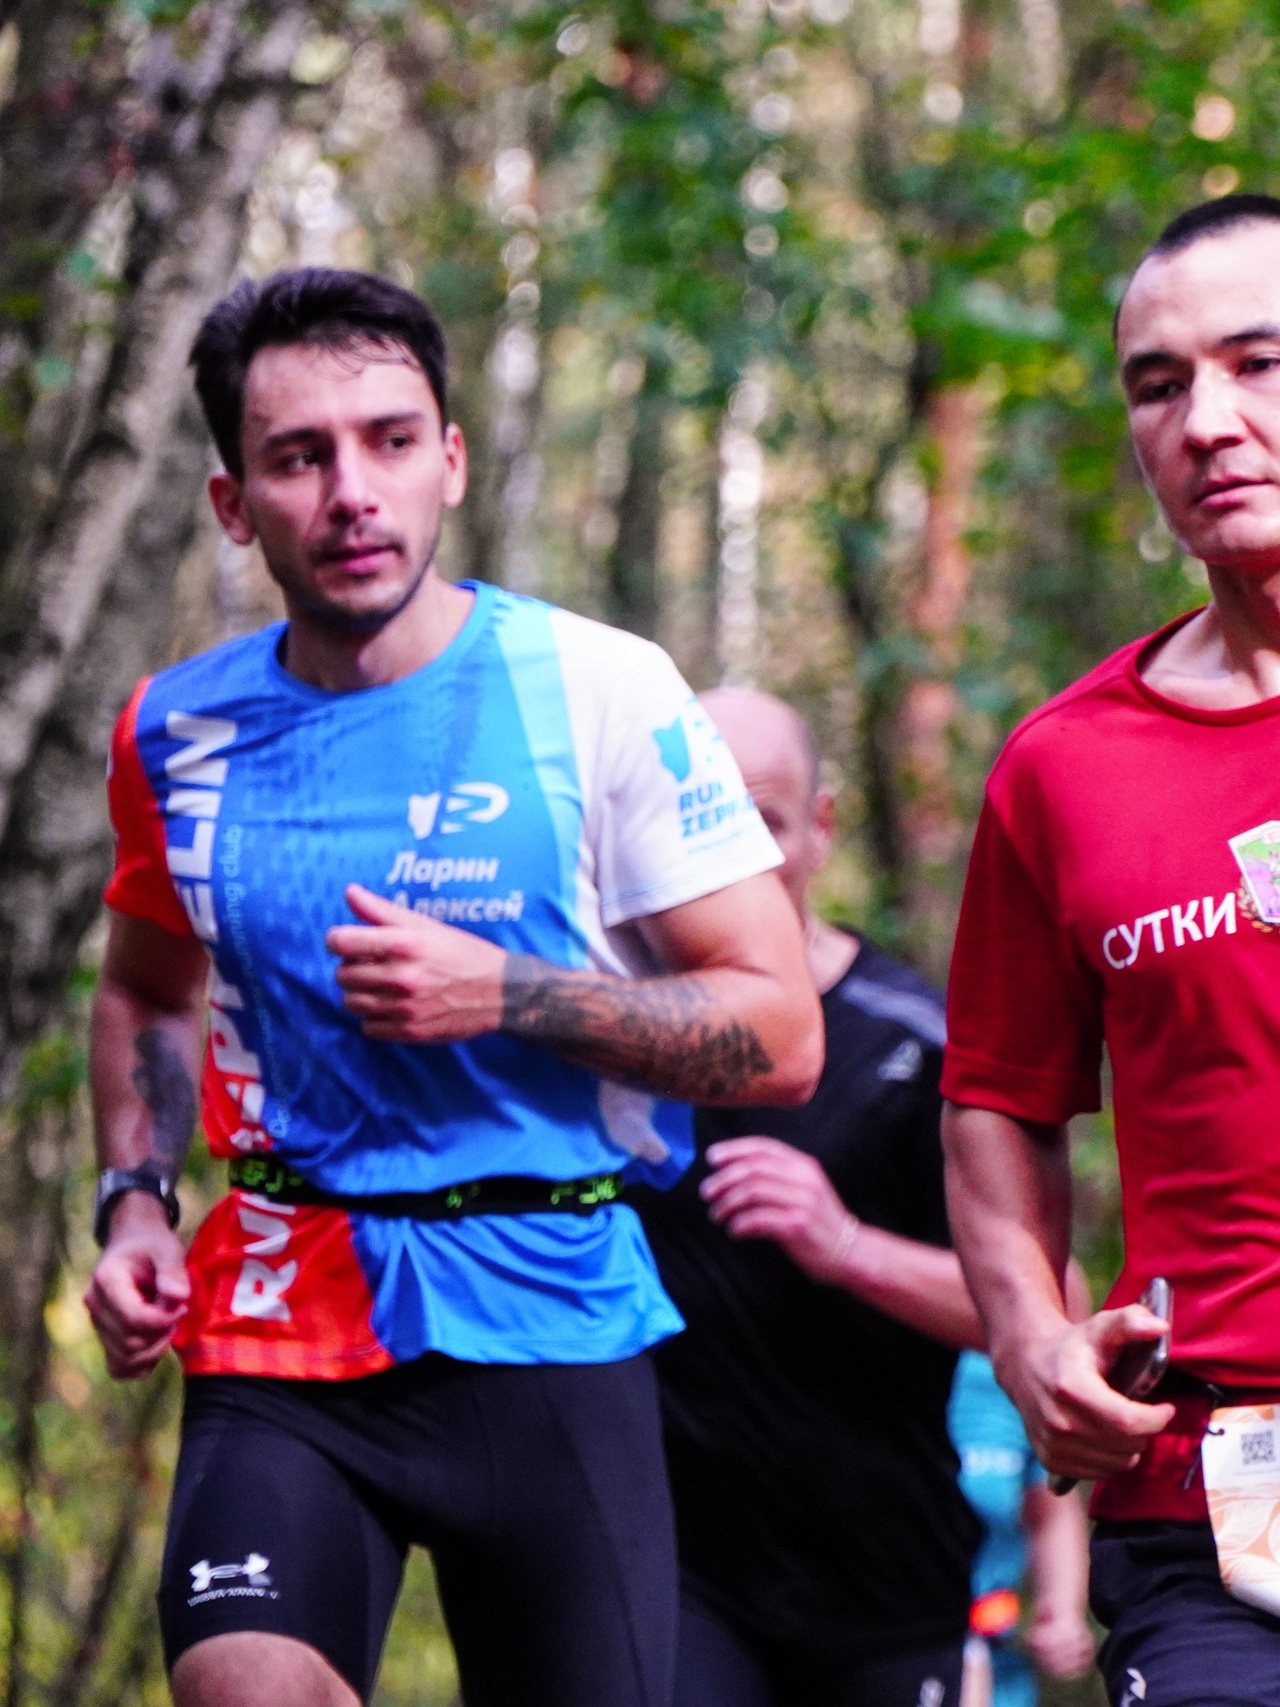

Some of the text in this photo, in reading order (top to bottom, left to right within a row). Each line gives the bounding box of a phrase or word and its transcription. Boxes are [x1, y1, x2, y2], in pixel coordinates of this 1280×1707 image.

[218, 824, 243, 878] club
[386, 851, 500, 891] Ларин
[1102, 892, 1238, 970] СУТКИ
